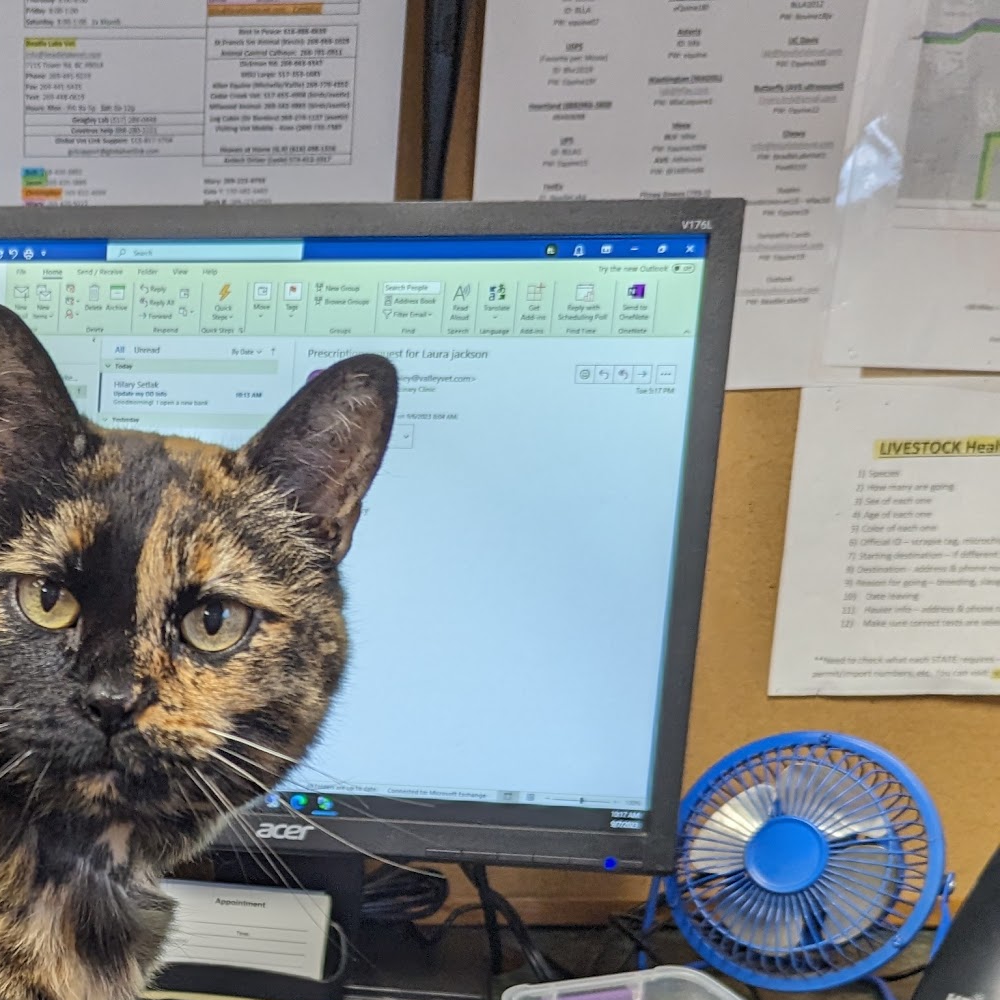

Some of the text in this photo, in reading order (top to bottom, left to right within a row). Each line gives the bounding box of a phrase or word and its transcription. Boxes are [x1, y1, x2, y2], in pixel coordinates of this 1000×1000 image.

[682, 220, 712, 230] V176L
[880, 441, 960, 455] LIVESTOCK
[256, 823, 315, 840] acer
[215, 898, 266, 908] Appointment
